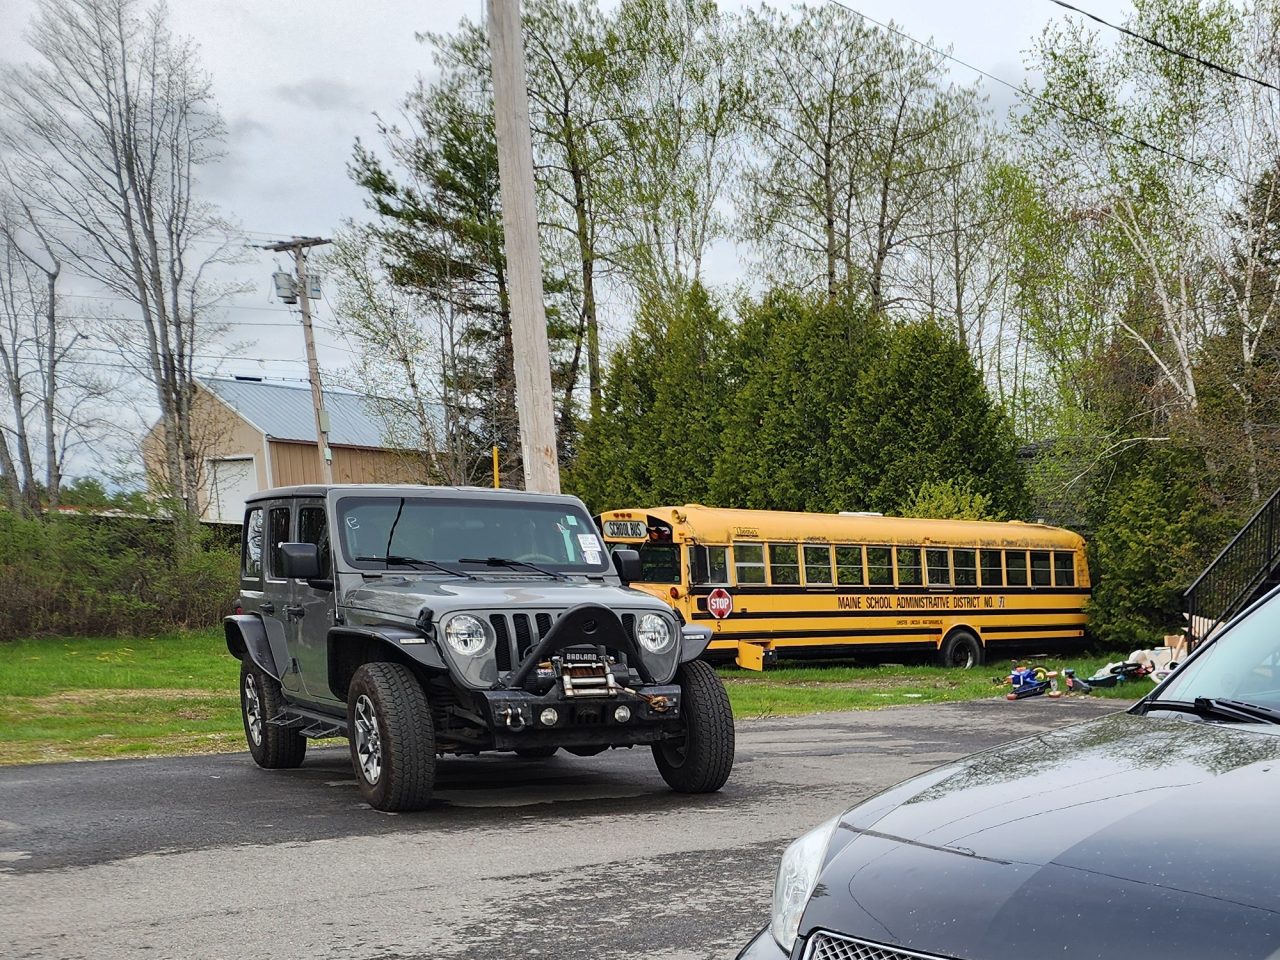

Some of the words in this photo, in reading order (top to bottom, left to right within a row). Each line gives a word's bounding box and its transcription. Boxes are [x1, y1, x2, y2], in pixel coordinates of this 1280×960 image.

[608, 521, 630, 537] SCHOOL
[630, 521, 642, 537] BUS
[711, 599, 729, 610] STOP
[837, 596, 862, 610] MAINE
[866, 596, 893, 610] SCHOOL
[896, 596, 950, 609] ADMINISTRATIVE
[953, 596, 980, 609] DISTRICT
[716, 621, 721, 631] 5
[566, 653, 597, 661] BADLAND
